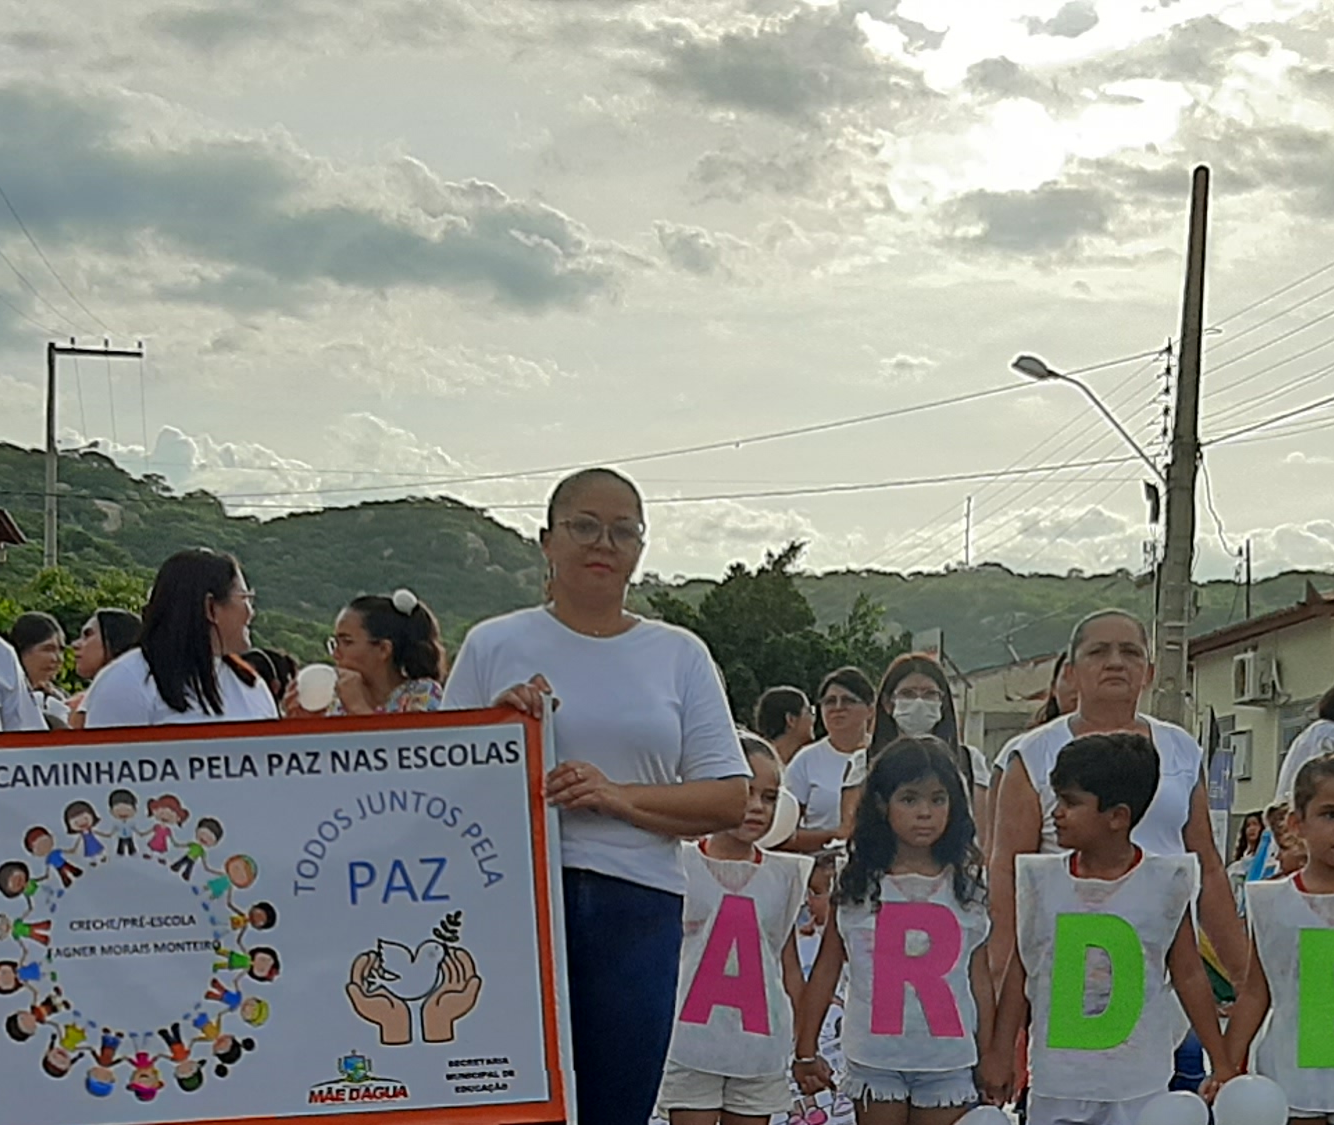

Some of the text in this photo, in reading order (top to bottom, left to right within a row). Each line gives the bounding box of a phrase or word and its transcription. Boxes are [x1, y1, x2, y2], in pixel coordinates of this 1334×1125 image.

[188, 754, 259, 780] PELA
[267, 751, 322, 776] PAZ
[331, 748, 389, 774] NAS
[398, 740, 520, 770] ESCOLAS
[293, 790, 514, 897] TODOS JUNTOS PELA
[348, 857, 450, 905] PAZ
[100, 944, 150, 957] MORAIS
[153, 939, 221, 954] MONTEIRO
[680, 895, 771, 1036] A
[871, 901, 964, 1037] R
[1047, 914, 1145, 1050] D
[308, 1086, 347, 1104] MÃE
